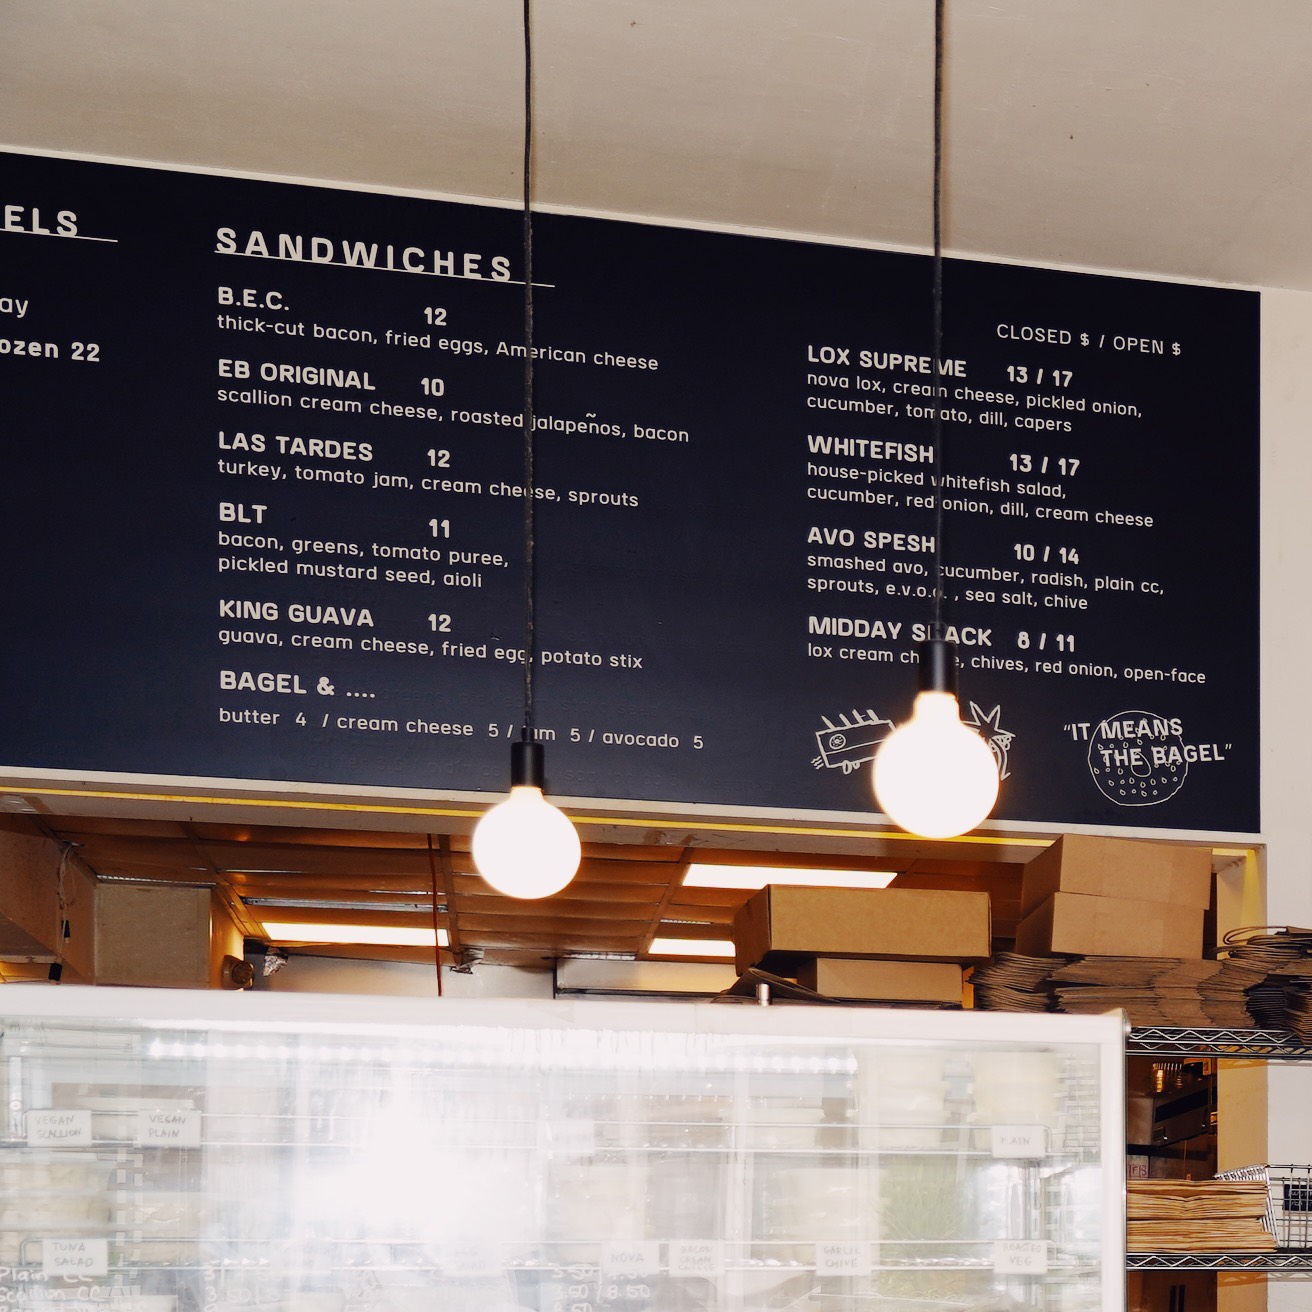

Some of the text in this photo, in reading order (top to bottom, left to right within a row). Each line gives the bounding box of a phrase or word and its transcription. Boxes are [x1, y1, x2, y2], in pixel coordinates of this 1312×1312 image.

[215, 227, 513, 283] SANDWICHES
[218, 286, 447, 326] B.E.C. 12
[71, 341, 100, 362] 22
[216, 314, 659, 371] thick-cut bacon, fried eggs, American cheese
[996, 323, 1164, 355] CLOSED OPEN
[218, 358, 445, 397] EB ORIGINAL 10
[808, 344, 1073, 388] LOX SUPREME 13 17
[807, 373, 1142, 419] nova onion,
[217, 389, 626, 438] scallion cream roasted jalapeños,
[807, 396, 1072, 432] cucumber, dill, capers
[218, 430, 373, 462] LAS TARDES
[807, 434, 935, 464] WHITEFISH
[217, 458, 639, 507] turkey, tomato jam, sprouts
[807, 461, 1066, 500] house-picked salad,
[906, 495, 935, 509] red
[219, 501, 450, 539] BLT 11
[291, 539, 509, 568] greens, puree,
[807, 526, 1080, 565] AVO SPESH 14
[218, 555, 482, 588] pickled mustard seed, aioli
[807, 555, 1164, 595] smashed radish, plain cc,
[219, 599, 374, 628] KING GUAVA
[965, 590, 1088, 610] sea salt, chive
[808, 615, 992, 647] MIDDAY SACK
[541, 650, 643, 669] potato stix
[971, 654, 1029, 673] chives,
[1123, 667, 1206, 684] open-face
[220, 670, 308, 695] BAGEL
[219, 707, 680, 748] butter cheese avocado
[1100, 718, 1184, 741] MEANS
[1102, 747, 1143, 769] THE
